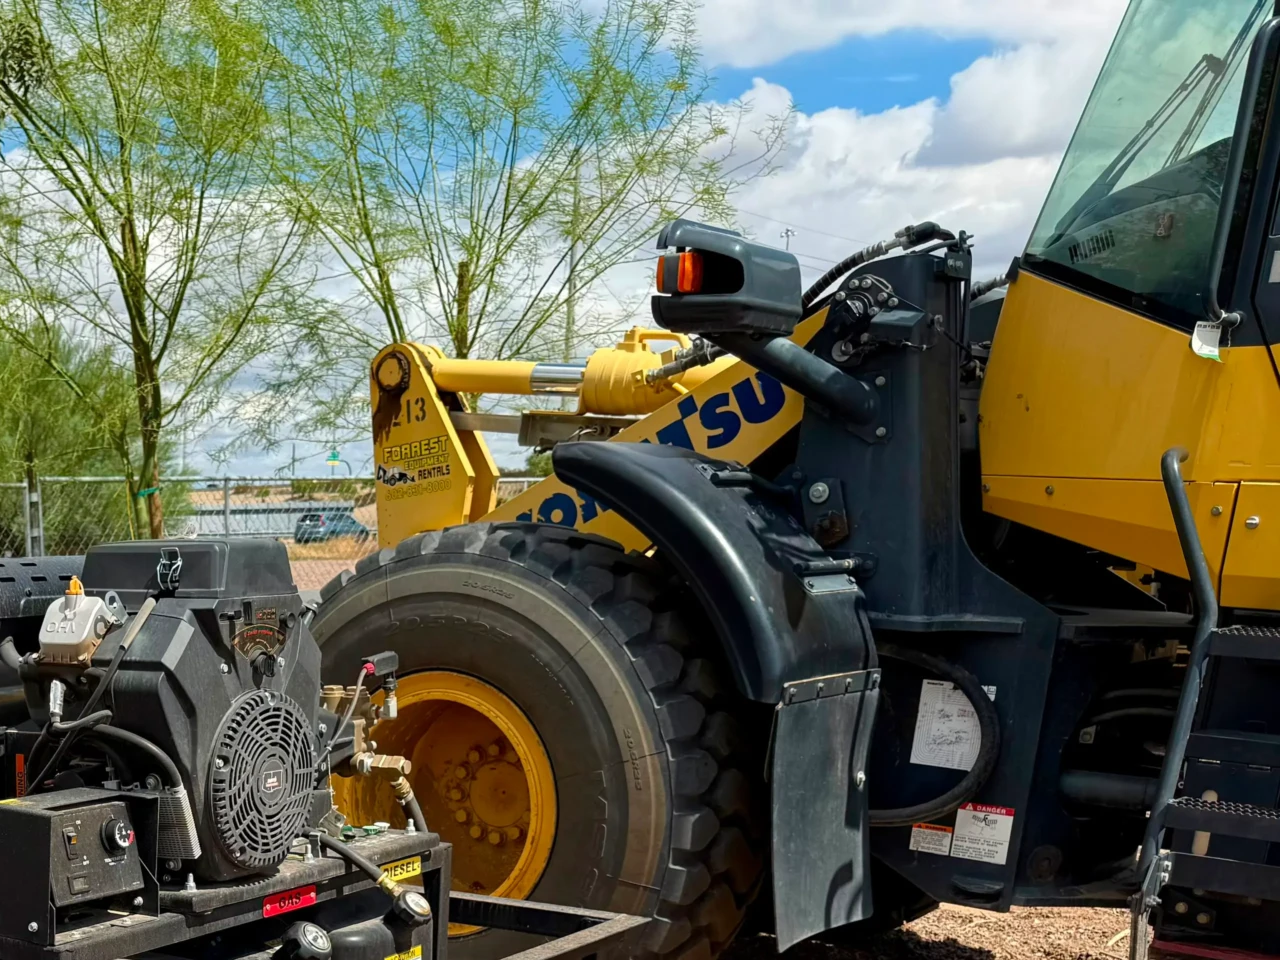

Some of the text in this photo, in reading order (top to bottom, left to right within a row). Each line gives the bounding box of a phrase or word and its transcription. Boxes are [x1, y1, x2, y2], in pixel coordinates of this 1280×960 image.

[383, 435, 448, 464] FORREST
[404, 454, 449, 470] EQUIPMENT
[418, 464, 450, 480] RENTALS
[977, 806, 1006, 815] DANGER
[384, 861, 417, 878] DIESEL
[278, 892, 302, 909] GAS
